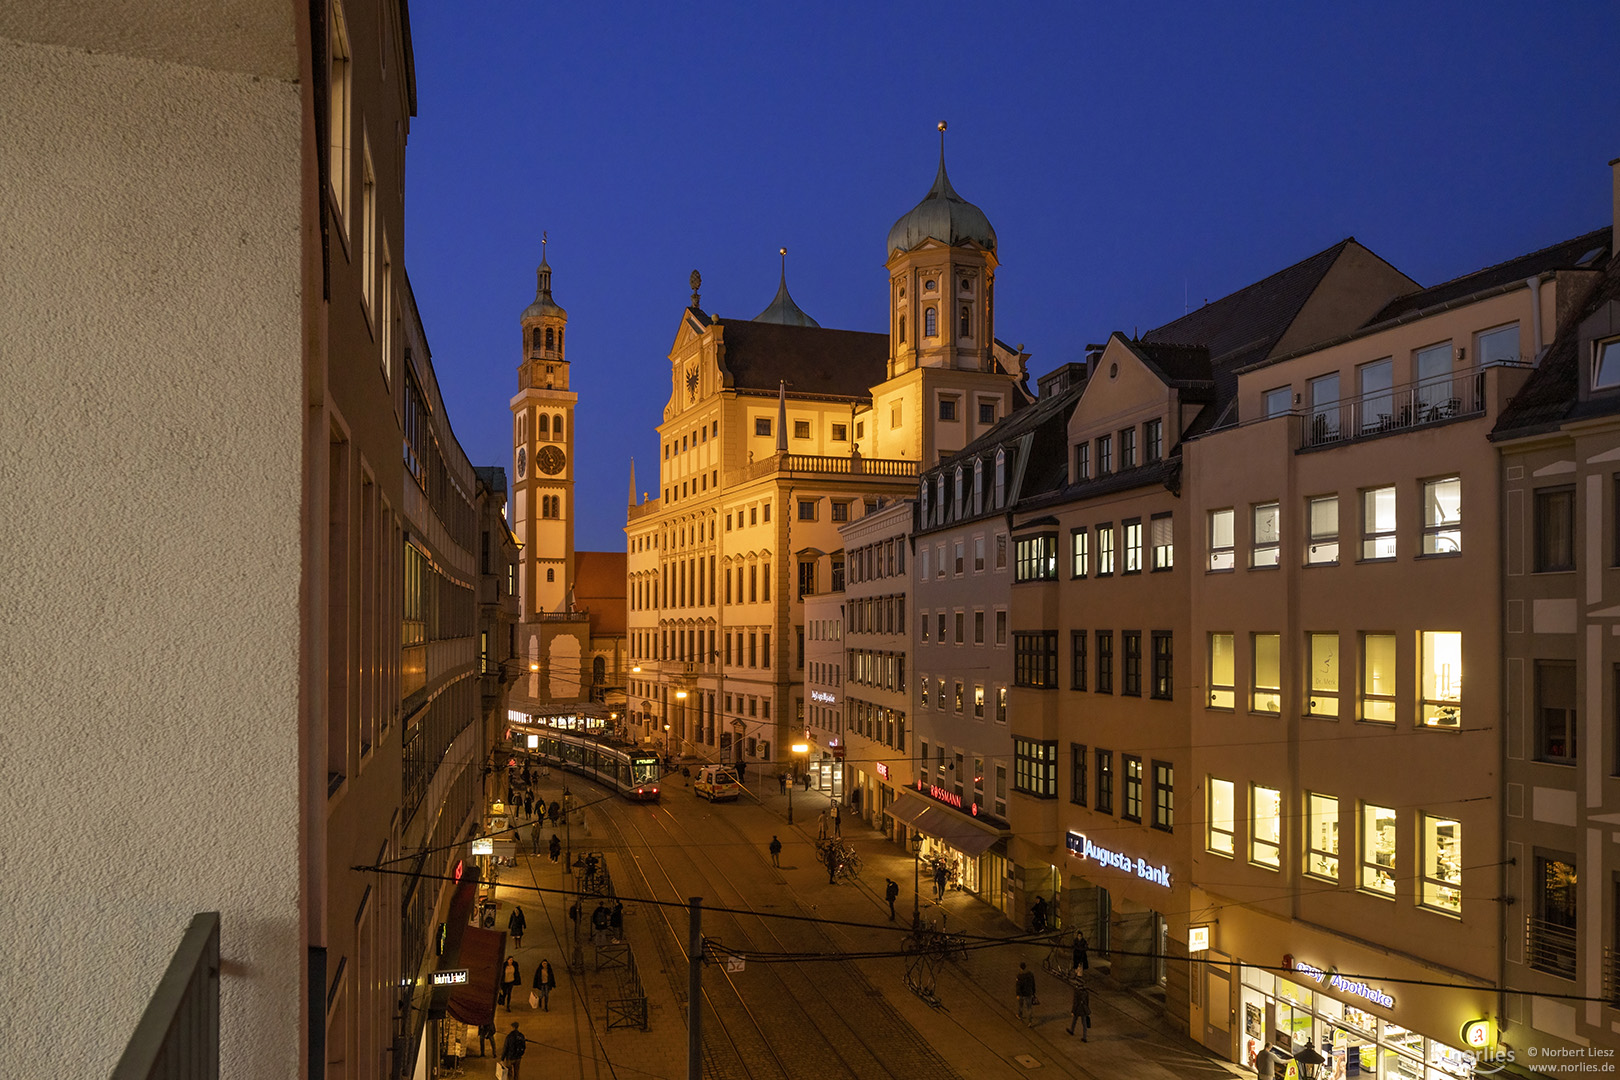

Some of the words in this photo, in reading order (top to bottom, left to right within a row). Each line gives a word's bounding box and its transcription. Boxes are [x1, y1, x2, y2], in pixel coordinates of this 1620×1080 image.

[930, 784, 962, 808] ROSSMANN
[1085, 839, 1171, 888] Augusta-Bank
[1332, 974, 1394, 1009] Apotheke
